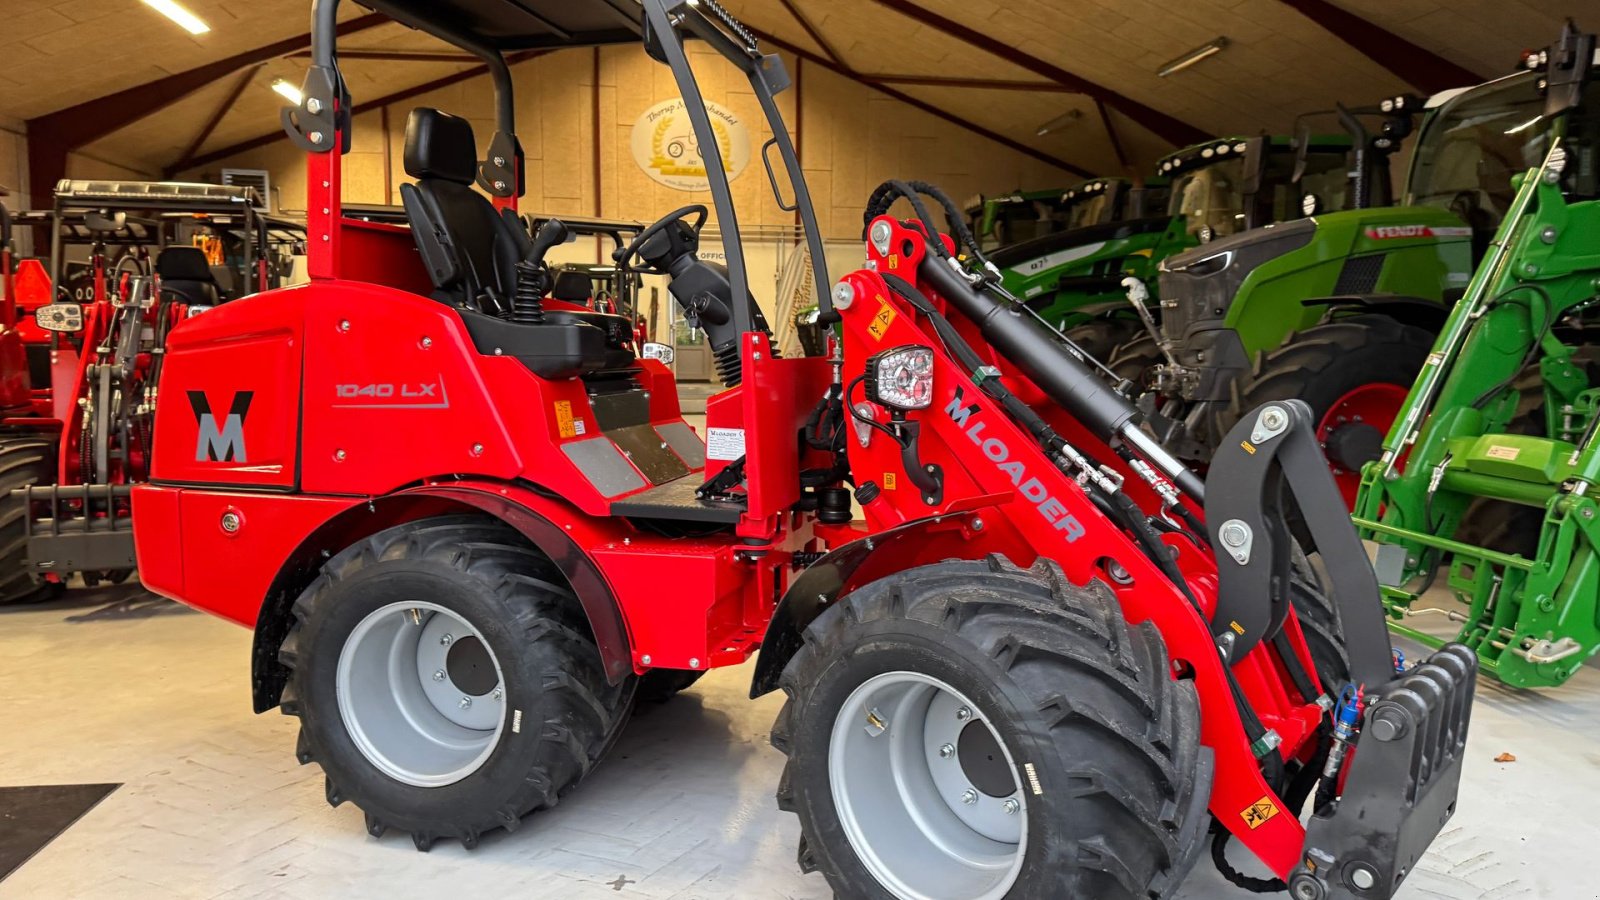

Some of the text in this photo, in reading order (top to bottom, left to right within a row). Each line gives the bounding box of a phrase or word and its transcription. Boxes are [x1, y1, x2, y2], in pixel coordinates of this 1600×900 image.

[646, 101, 738, 125] Thorup Mhandel
[1376, 225, 1427, 239] FENDT
[336, 383, 436, 397] 1040 LX
